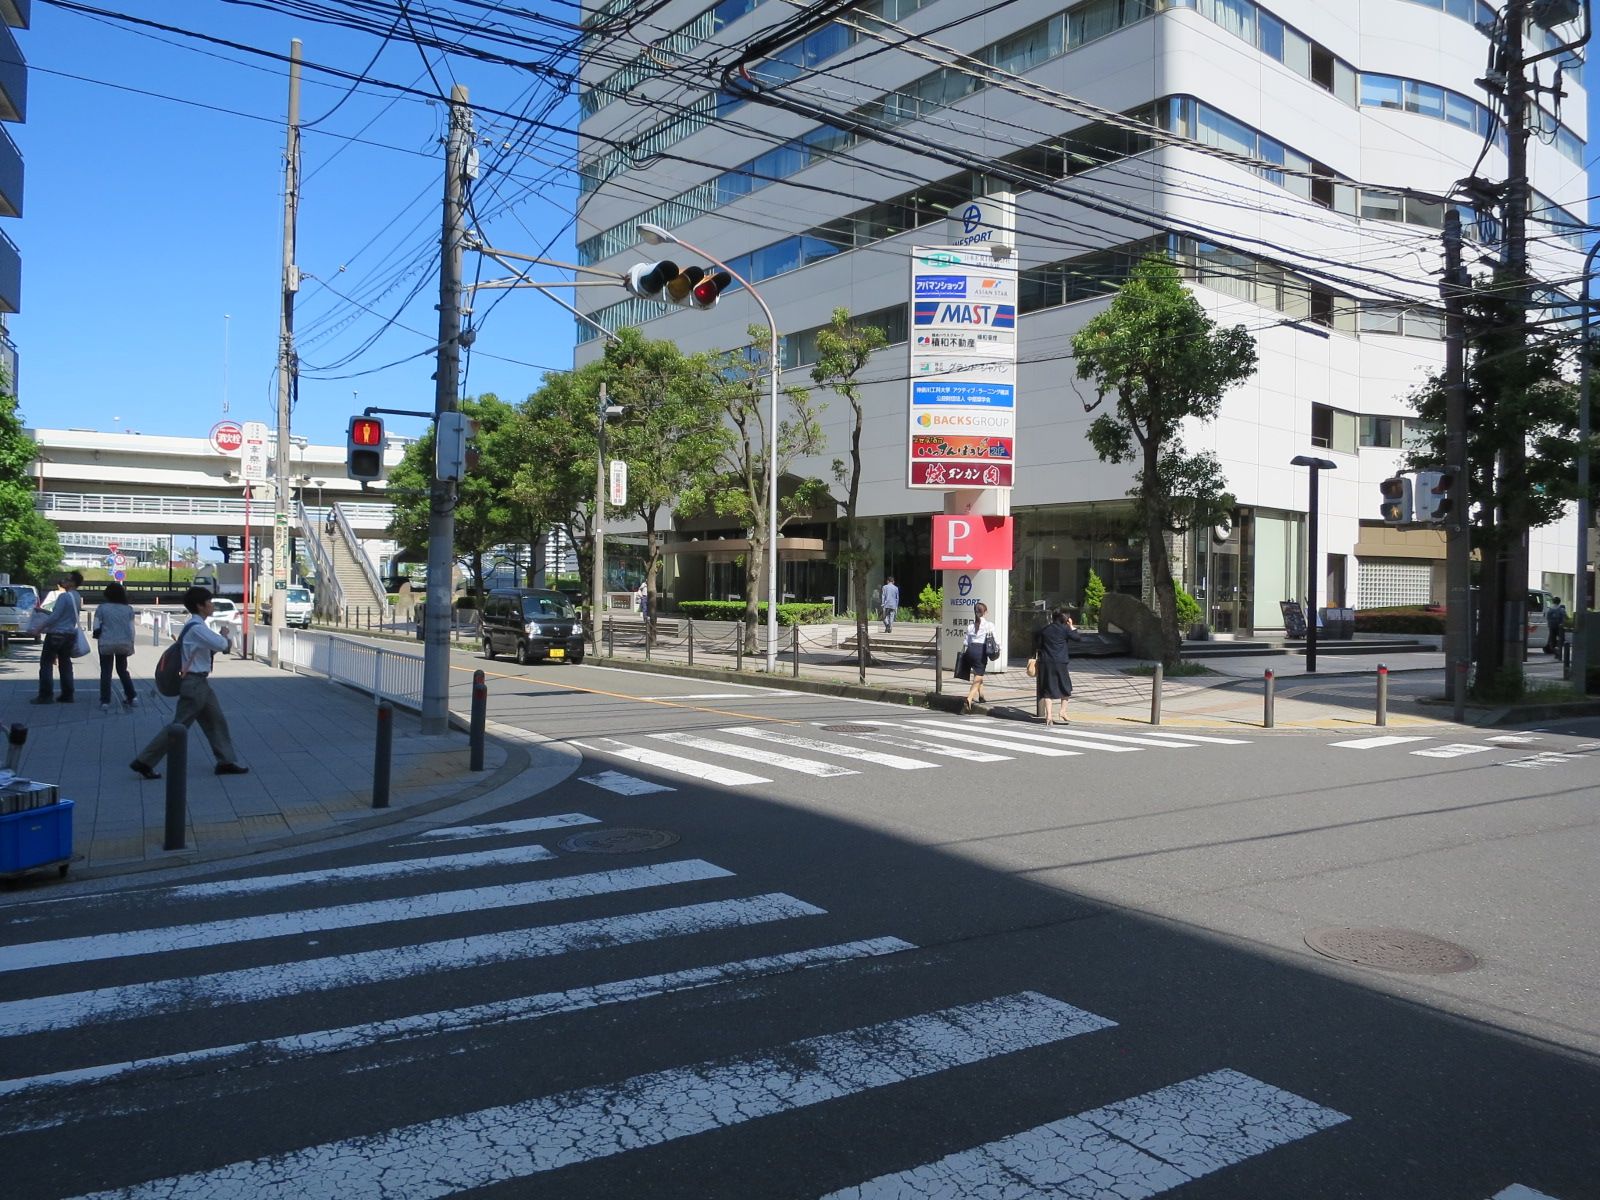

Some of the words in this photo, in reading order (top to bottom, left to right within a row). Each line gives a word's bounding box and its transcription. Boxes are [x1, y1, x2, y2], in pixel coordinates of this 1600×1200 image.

[952, 230, 993, 246] ESPORT
[916, 281, 964, 291] アパマンショップ
[941, 304, 991, 325] MAST
[931, 338, 975, 348] 積和不動産
[933, 415, 1009, 428] BACKSGROUP
[217, 433, 241, 444] 消火栓
[990, 446, 1006, 457] 2F
[948, 520, 971, 553] P
